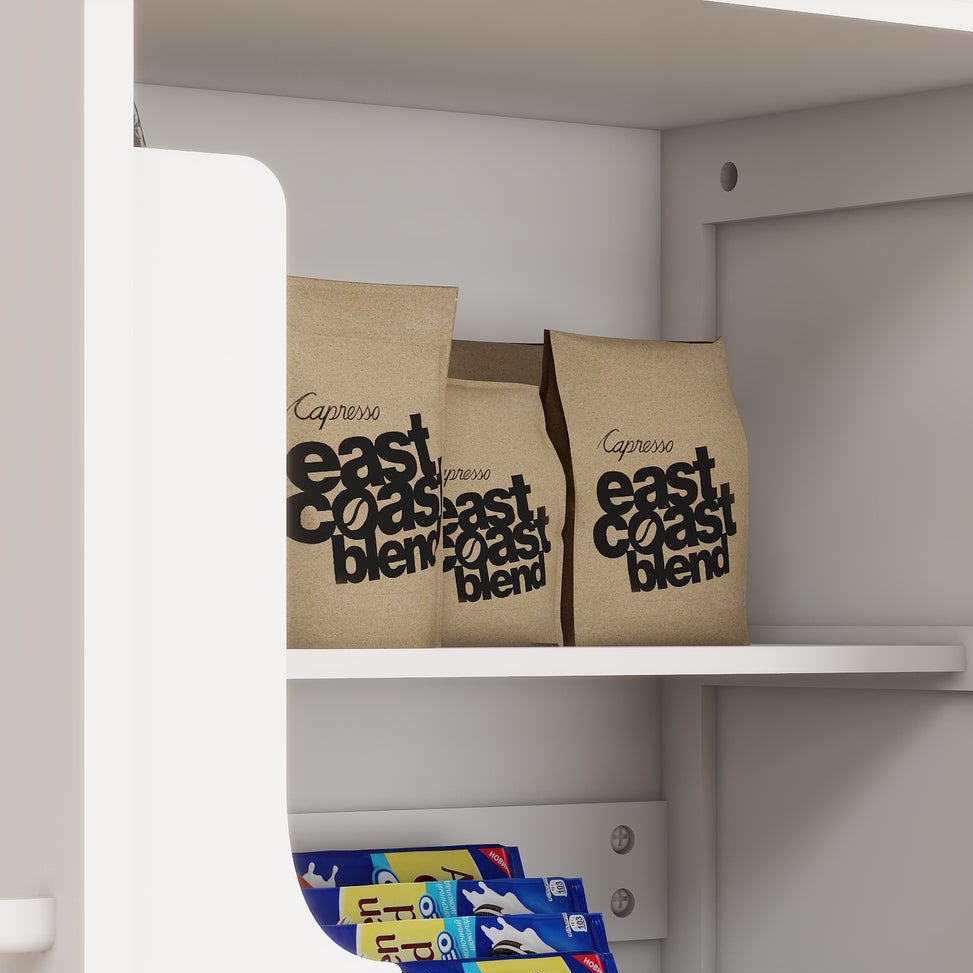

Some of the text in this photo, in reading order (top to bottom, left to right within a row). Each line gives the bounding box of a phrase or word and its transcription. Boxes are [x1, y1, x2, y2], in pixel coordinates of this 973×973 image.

[287, 392, 380, 430] Capresso
[286, 413, 437, 493] east
[597, 429, 674, 462] Capresso
[443, 468, 491, 487] presso
[597, 446, 718, 515] east
[593, 482, 737, 559] coast
[454, 552, 546, 603] blend
[626, 534, 730, 592] blend
